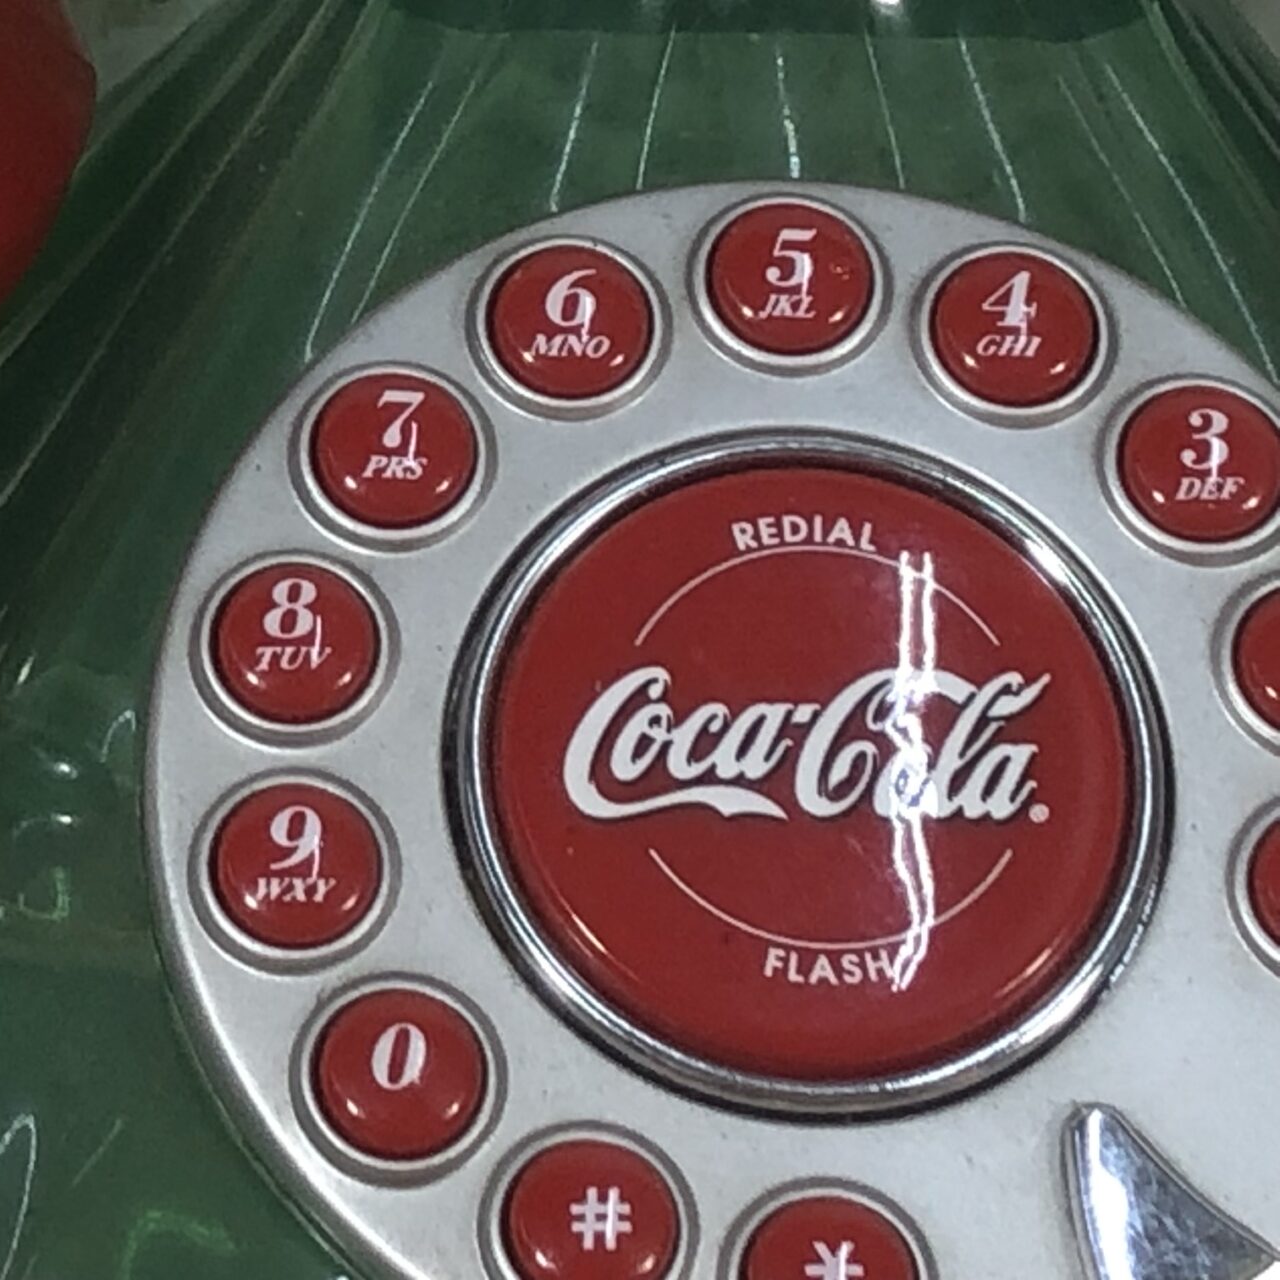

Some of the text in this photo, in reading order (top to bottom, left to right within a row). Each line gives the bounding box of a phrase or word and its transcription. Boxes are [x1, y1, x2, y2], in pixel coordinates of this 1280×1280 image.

[765, 228, 817, 287] 5
[545, 269, 597, 327] 6
[759, 294, 816, 319] JKL
[981, 270, 1037, 326] 4
[529, 335, 611, 359] MNO
[975, 335, 1042, 358] GHI
[377, 389, 425, 449] 7
[1179, 408, 1230, 471] 3
[362, 455, 427, 481] PRS
[1175, 477, 1245, 501] DEF
[731, 514, 877, 552] REDIAL
[262, 577, 318, 639] 8
[254, 646, 332, 671] TUV
[269, 805, 323, 871] 9
[253, 877, 337, 903] WXY
[764, 947, 897, 986] FLASH
